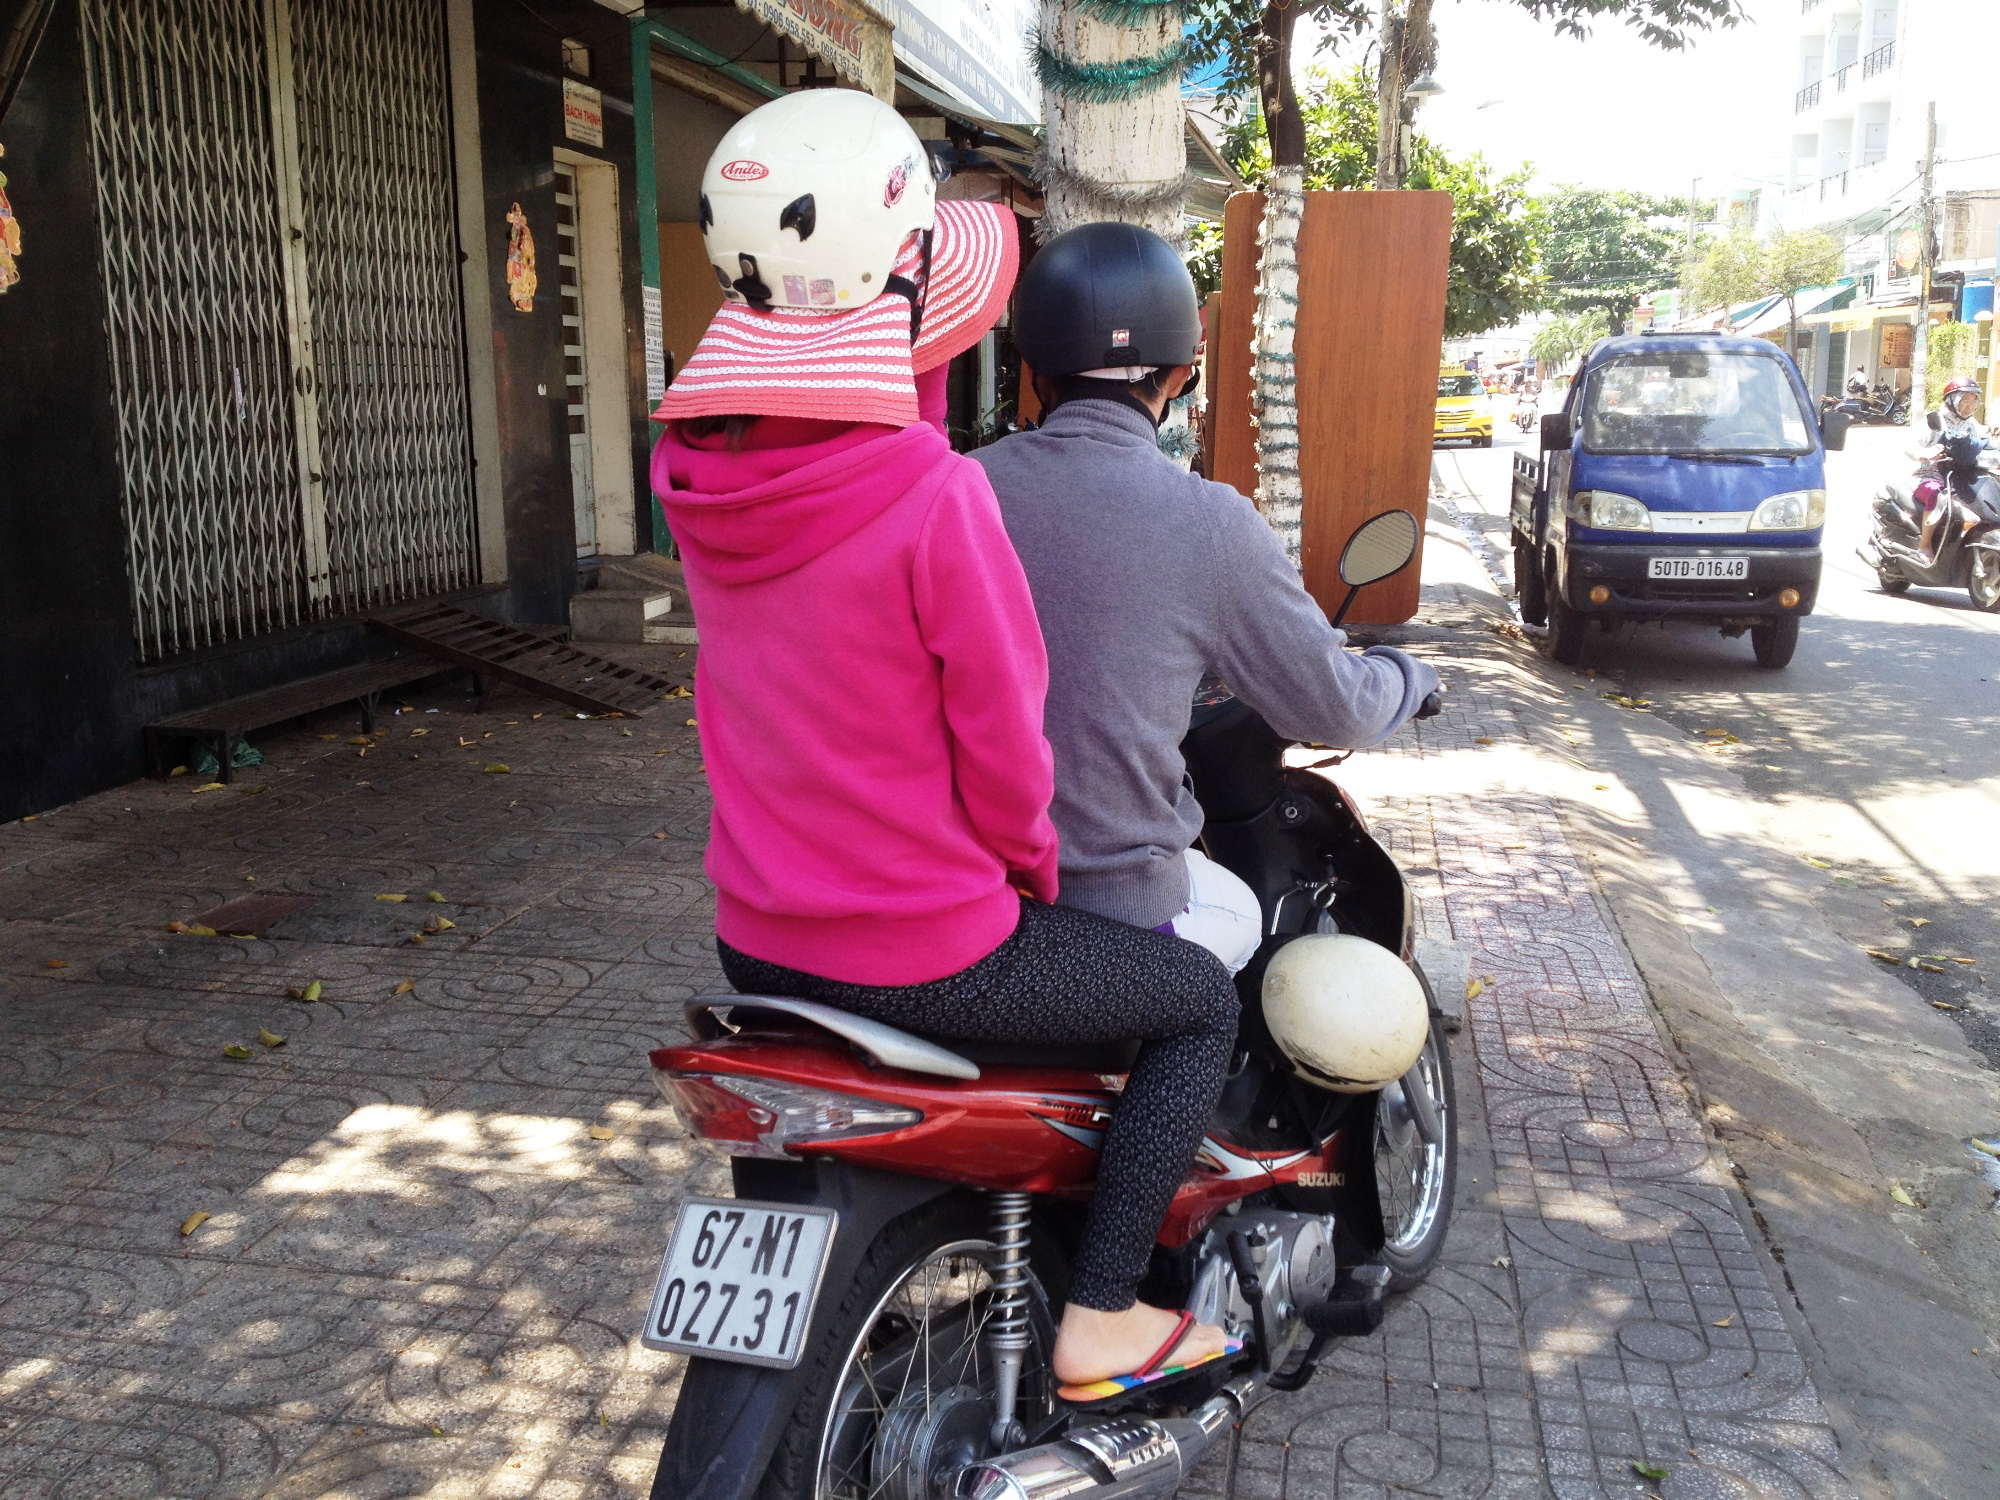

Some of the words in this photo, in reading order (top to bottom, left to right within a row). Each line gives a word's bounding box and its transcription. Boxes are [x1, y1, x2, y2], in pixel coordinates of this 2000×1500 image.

[724, 161, 767, 175] Andes
[1297, 1171, 1346, 1187] SUZUKI
[692, 1210, 805, 1278] 67-N1
[657, 1278, 801, 1355] 027.31
